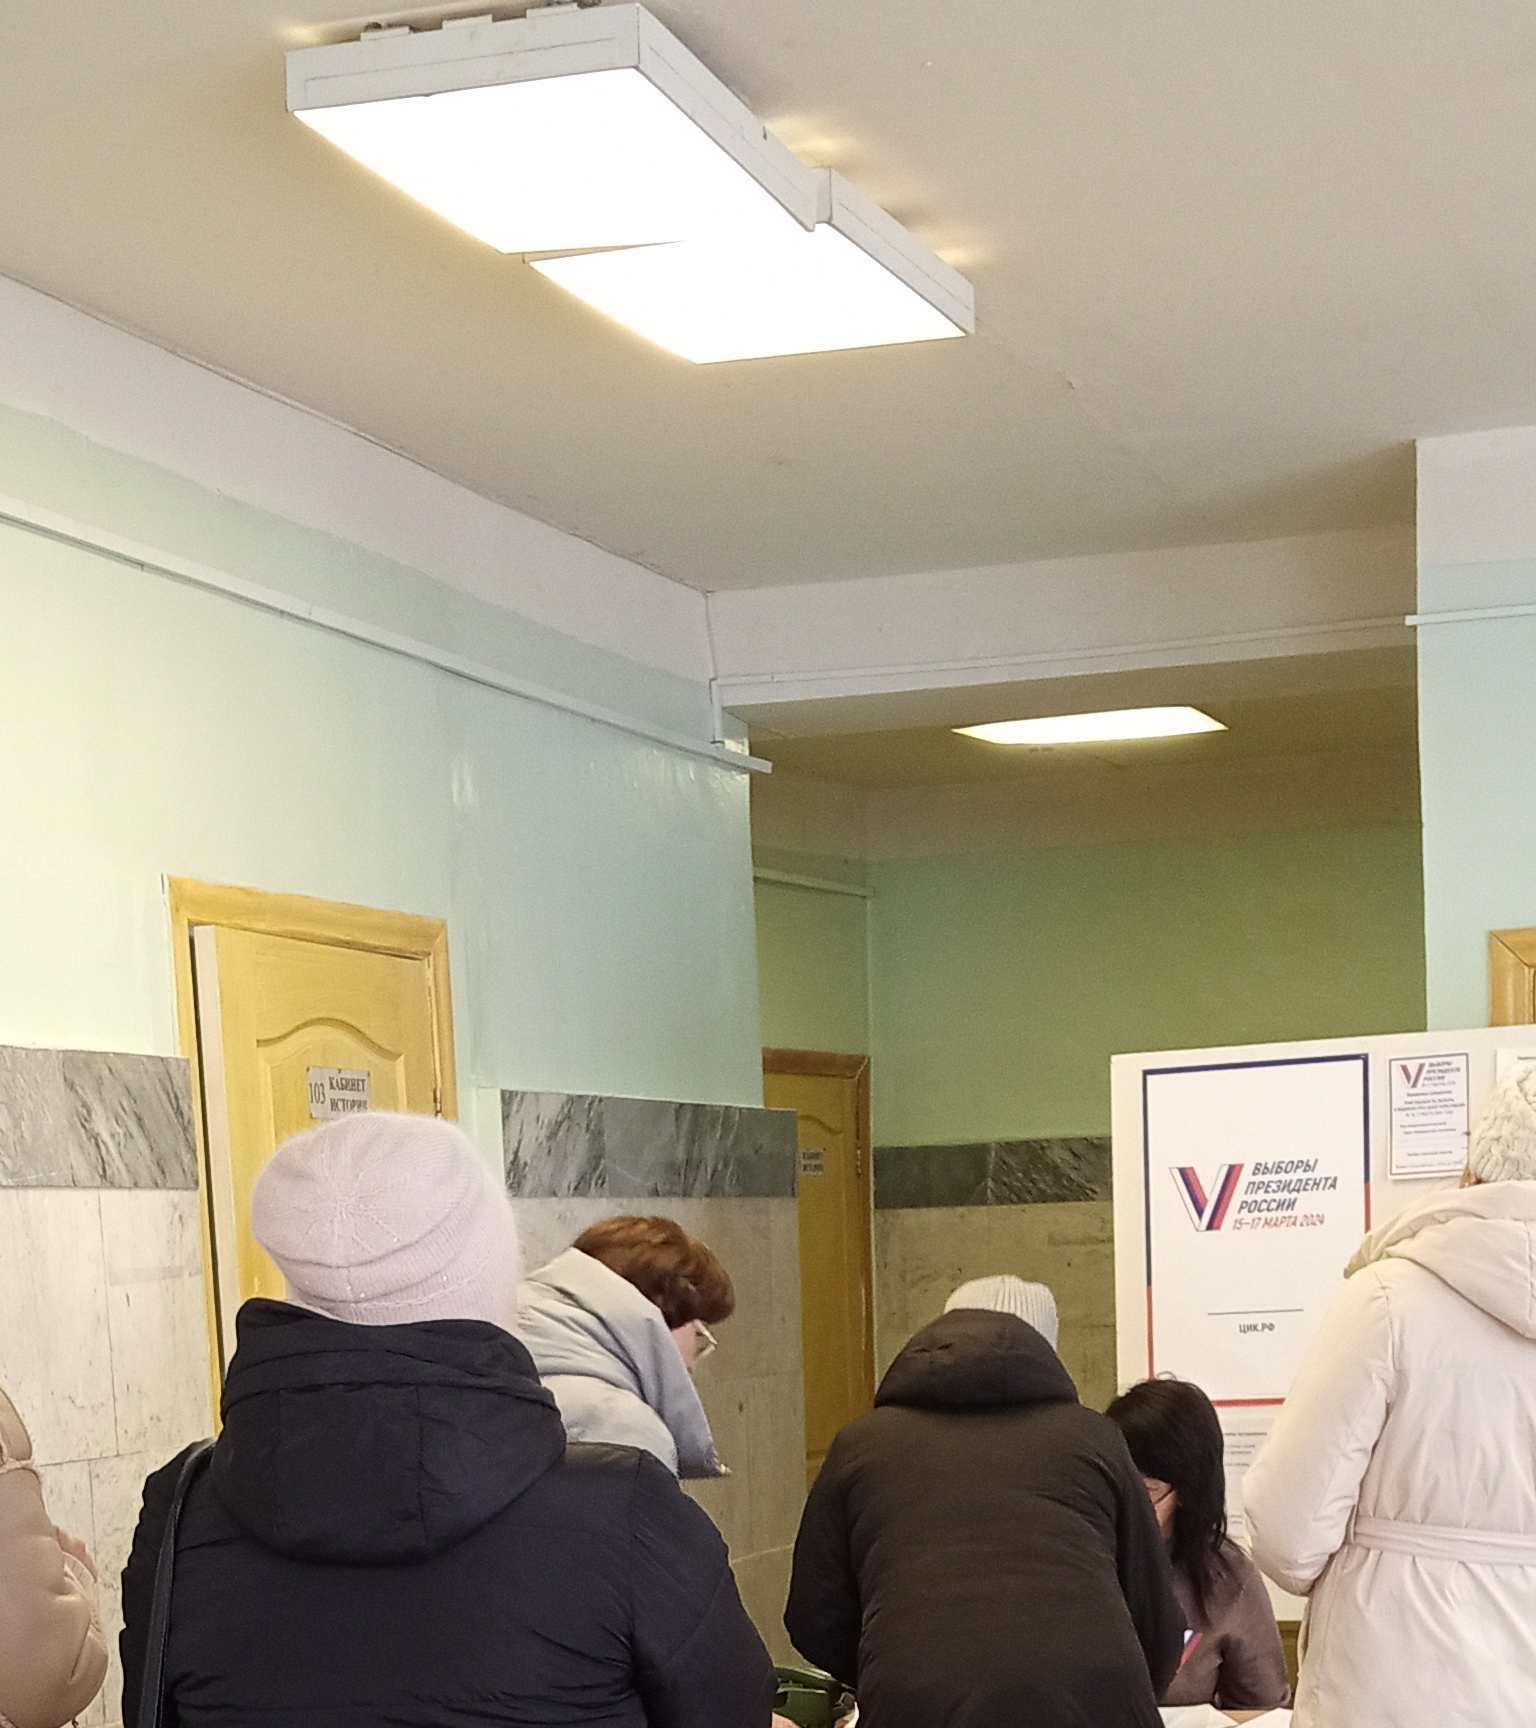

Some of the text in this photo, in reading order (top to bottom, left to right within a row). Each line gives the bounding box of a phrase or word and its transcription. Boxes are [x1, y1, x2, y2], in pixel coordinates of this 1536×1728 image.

[329, 1076, 366, 1092] КАБИНЕТ
[309, 1082, 326, 1104] 103
[1252, 1159, 1318, 1176] ВЫБОРЫ
[1244, 1176, 1338, 1195] ПРЕЗИДЕНТА
[1238, 1197, 1297, 1214] РОССИИ
[1262, 1216, 1297, 1228] МАРТА
[1299, 1214, 1325, 1226] 2024
[1239, 1323, 1275, 1334] ЦИК.РФ
